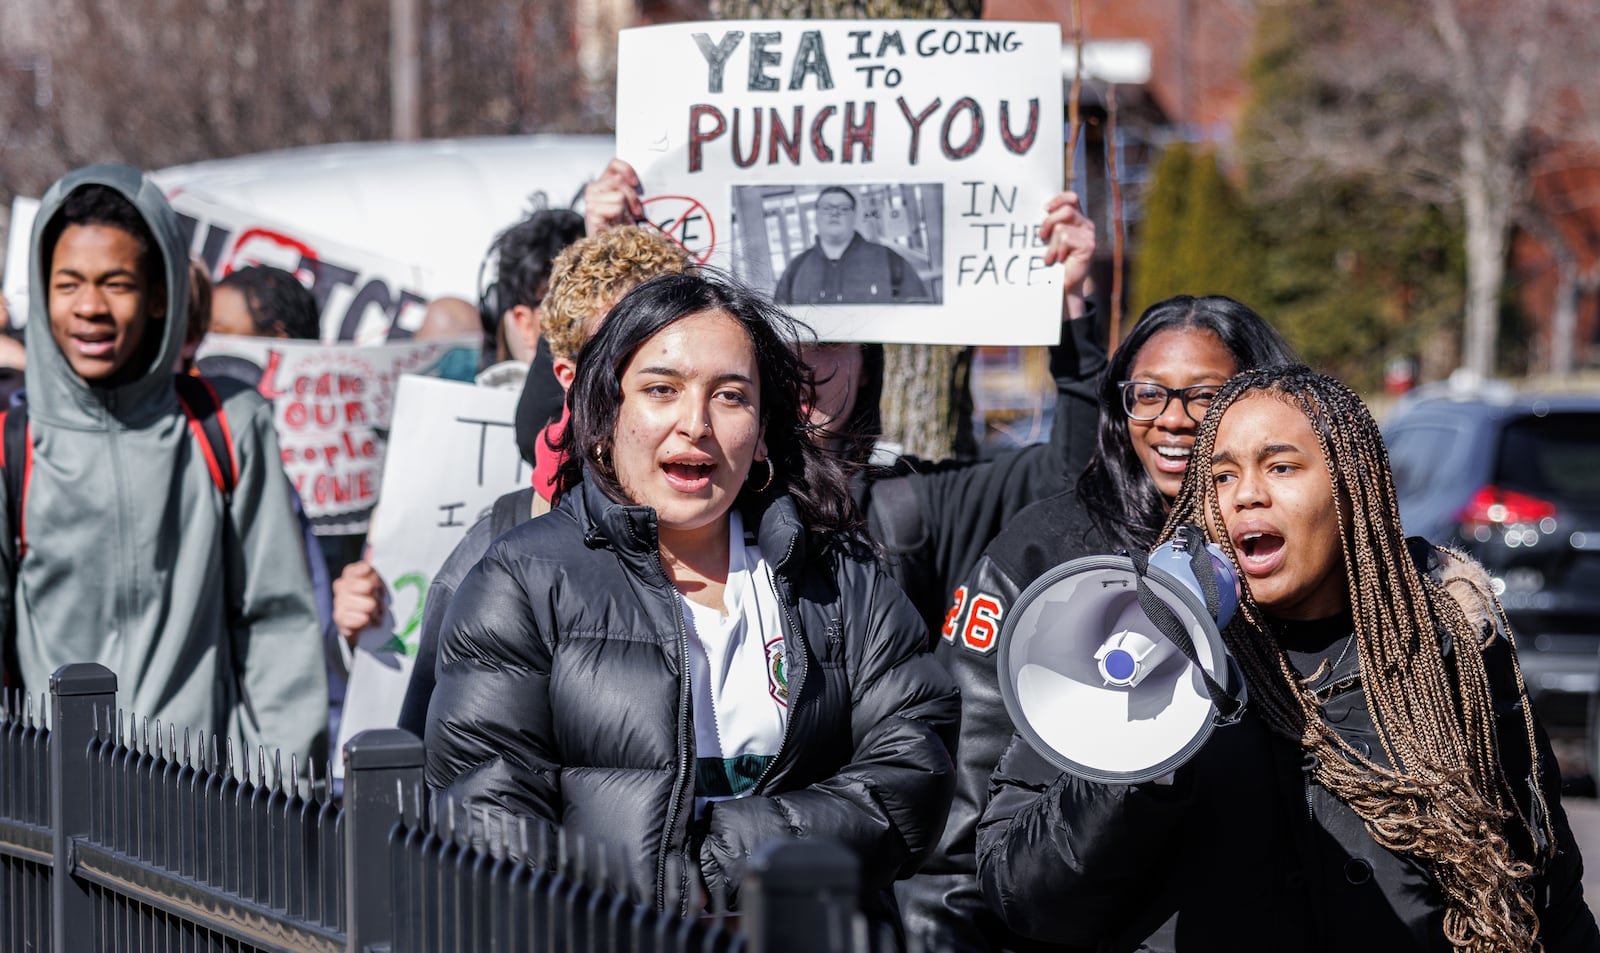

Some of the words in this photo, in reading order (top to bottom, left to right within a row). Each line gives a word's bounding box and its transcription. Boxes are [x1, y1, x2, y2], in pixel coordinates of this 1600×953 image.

[691, 30, 835, 93] YEA
[916, 29, 1023, 58] GOING
[856, 65, 903, 88] TO
[688, 101, 876, 174] PUNCH
[897, 96, 1039, 165] YOU
[961, 181, 1018, 217] IN
